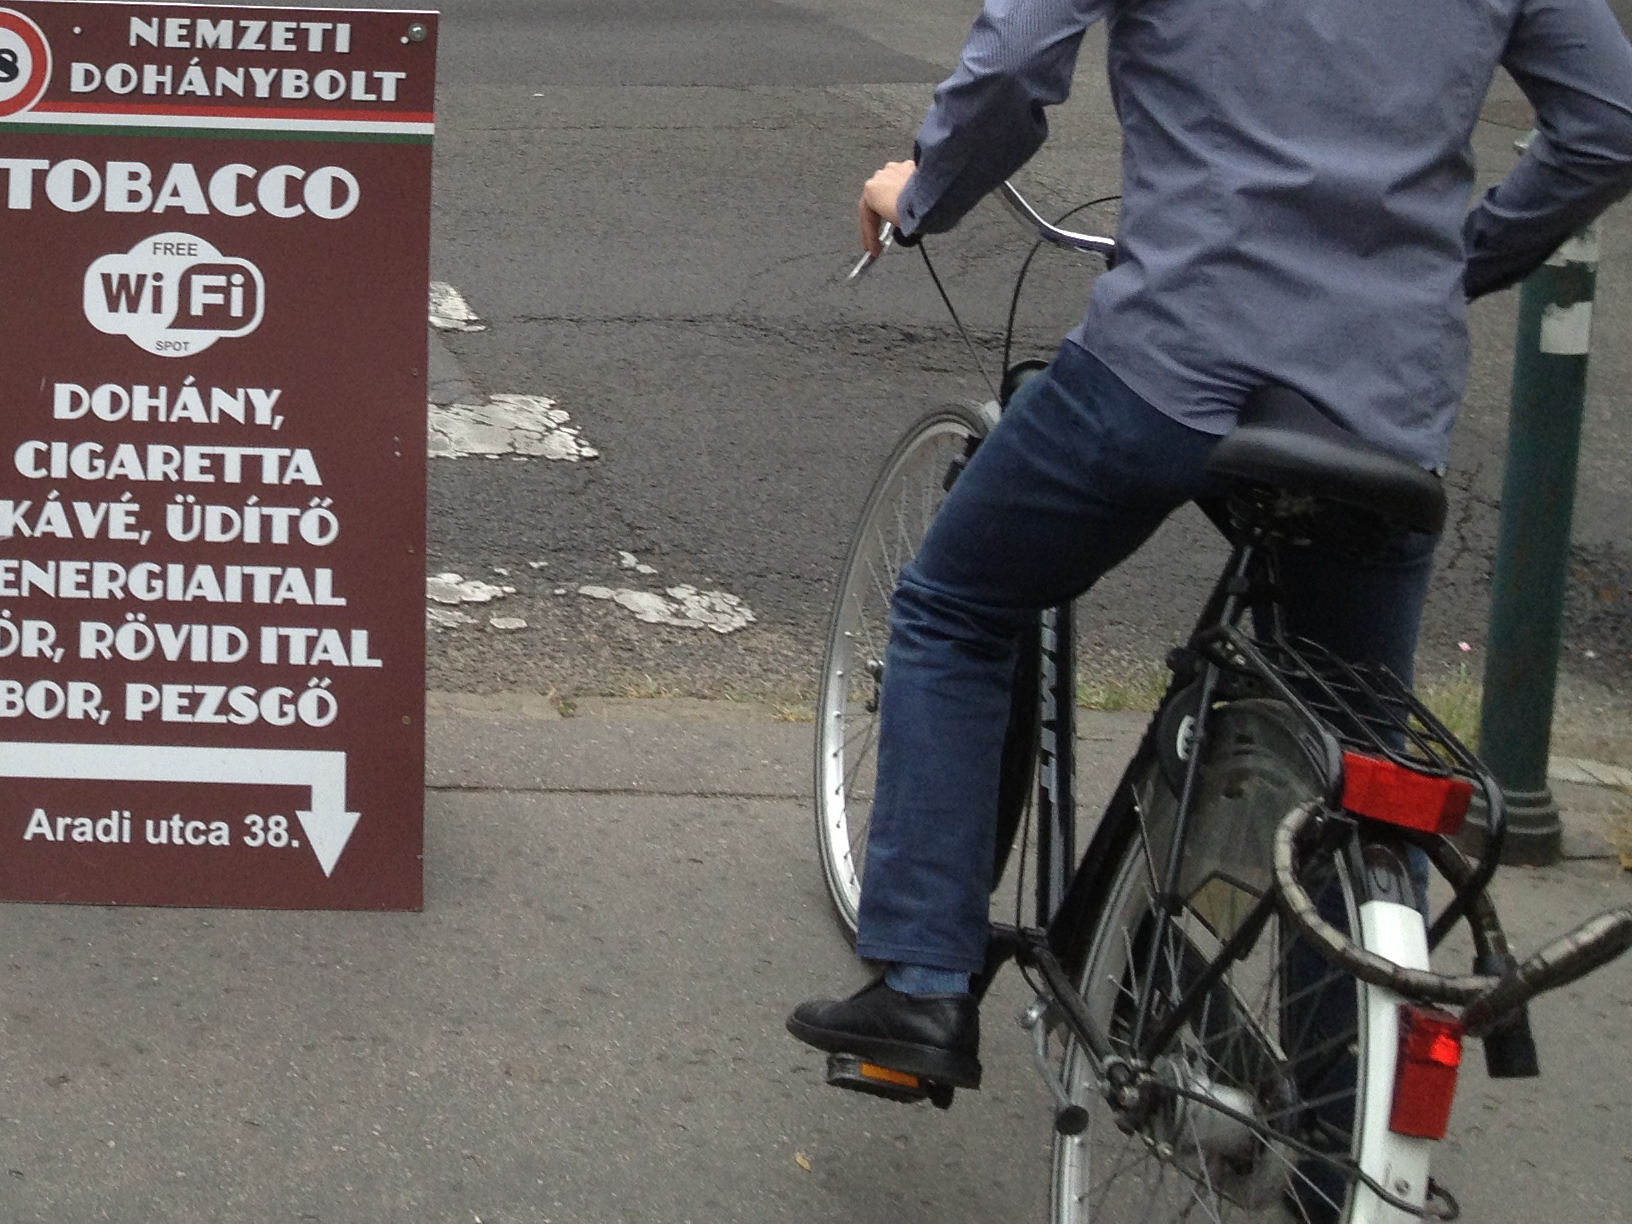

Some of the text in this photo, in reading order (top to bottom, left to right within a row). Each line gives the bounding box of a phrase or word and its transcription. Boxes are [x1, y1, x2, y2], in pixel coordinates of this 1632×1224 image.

[129, 18, 351, 53] NEMZETI
[70, 57, 406, 102] DOHÁNYBOLT
[153, 242, 198, 256] FREE
[155, 341, 190, 352] SPOT
[53, 375, 284, 431] DOHÁNY,
[14, 441, 323, 485] CIGARETTA
[166, 494, 340, 546] ÜDÍTŐ
[79, 612, 249, 662] RÖVID
[260, 626, 382, 668] ITAL
[125, 677, 338, 727] PEZSGŐ
[23, 808, 300, 849] Aradi utca 38.
